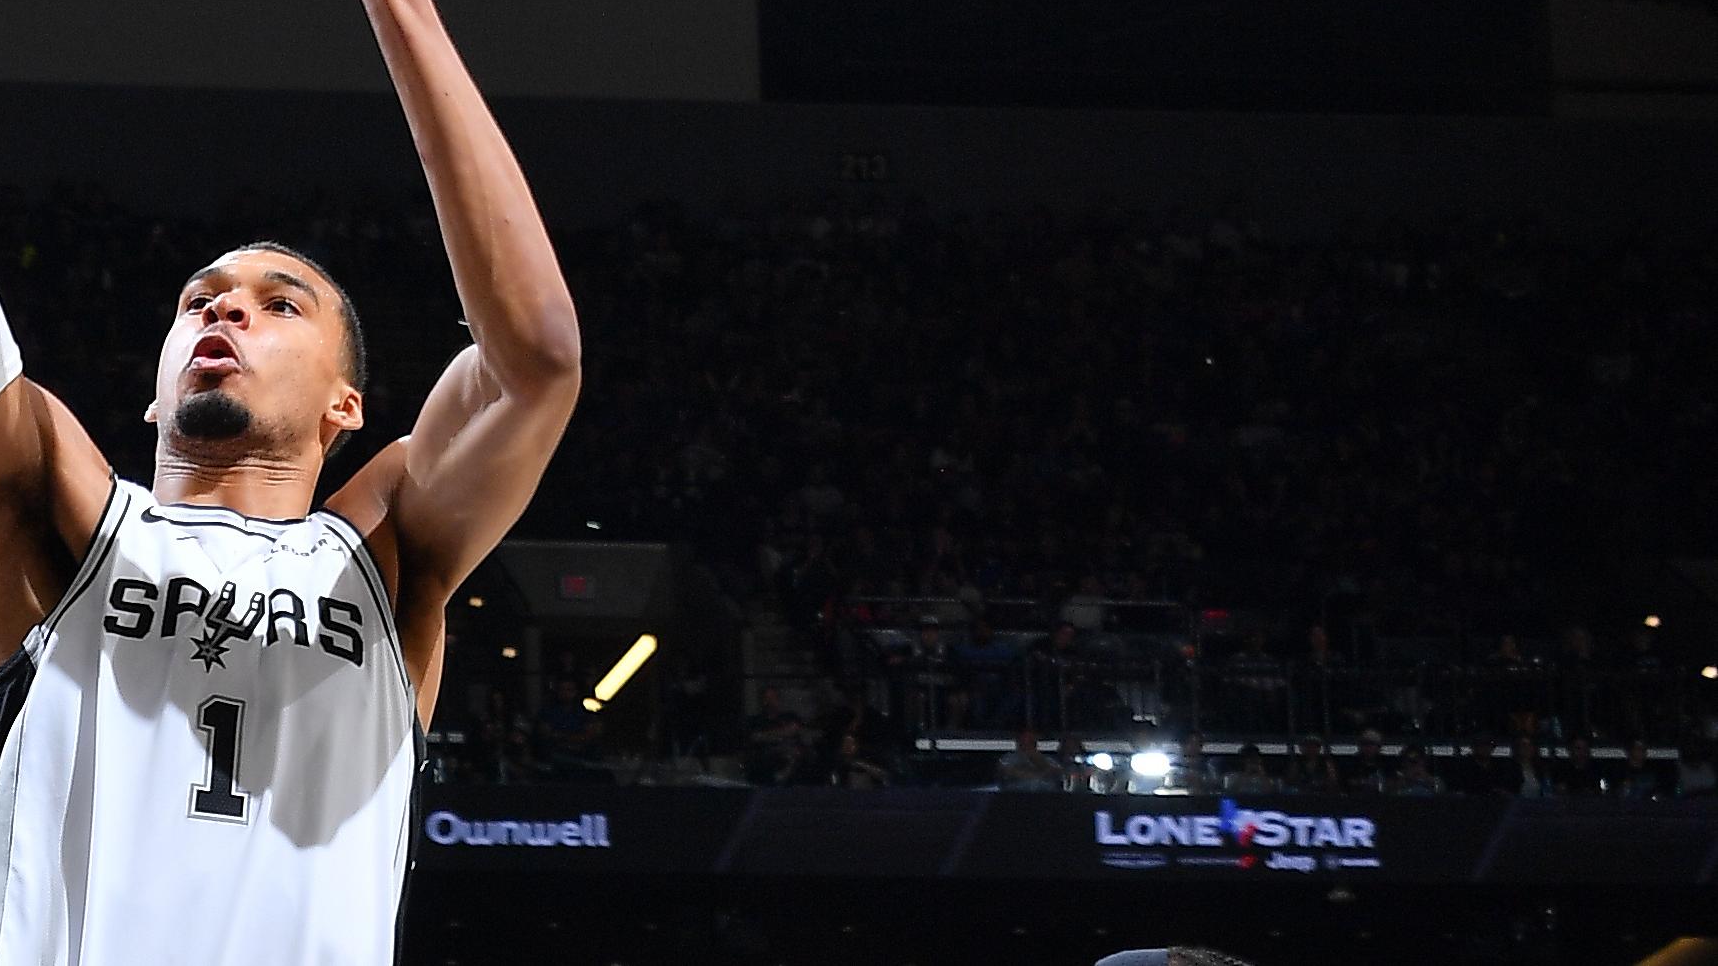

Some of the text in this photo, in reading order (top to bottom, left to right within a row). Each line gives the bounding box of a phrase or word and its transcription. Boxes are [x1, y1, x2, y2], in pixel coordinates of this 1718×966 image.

[103, 577, 364, 669] SPURS
[187, 695, 250, 825] 1
[425, 810, 610, 847] Ownwell
[1094, 810, 1376, 847] LONE STAR
